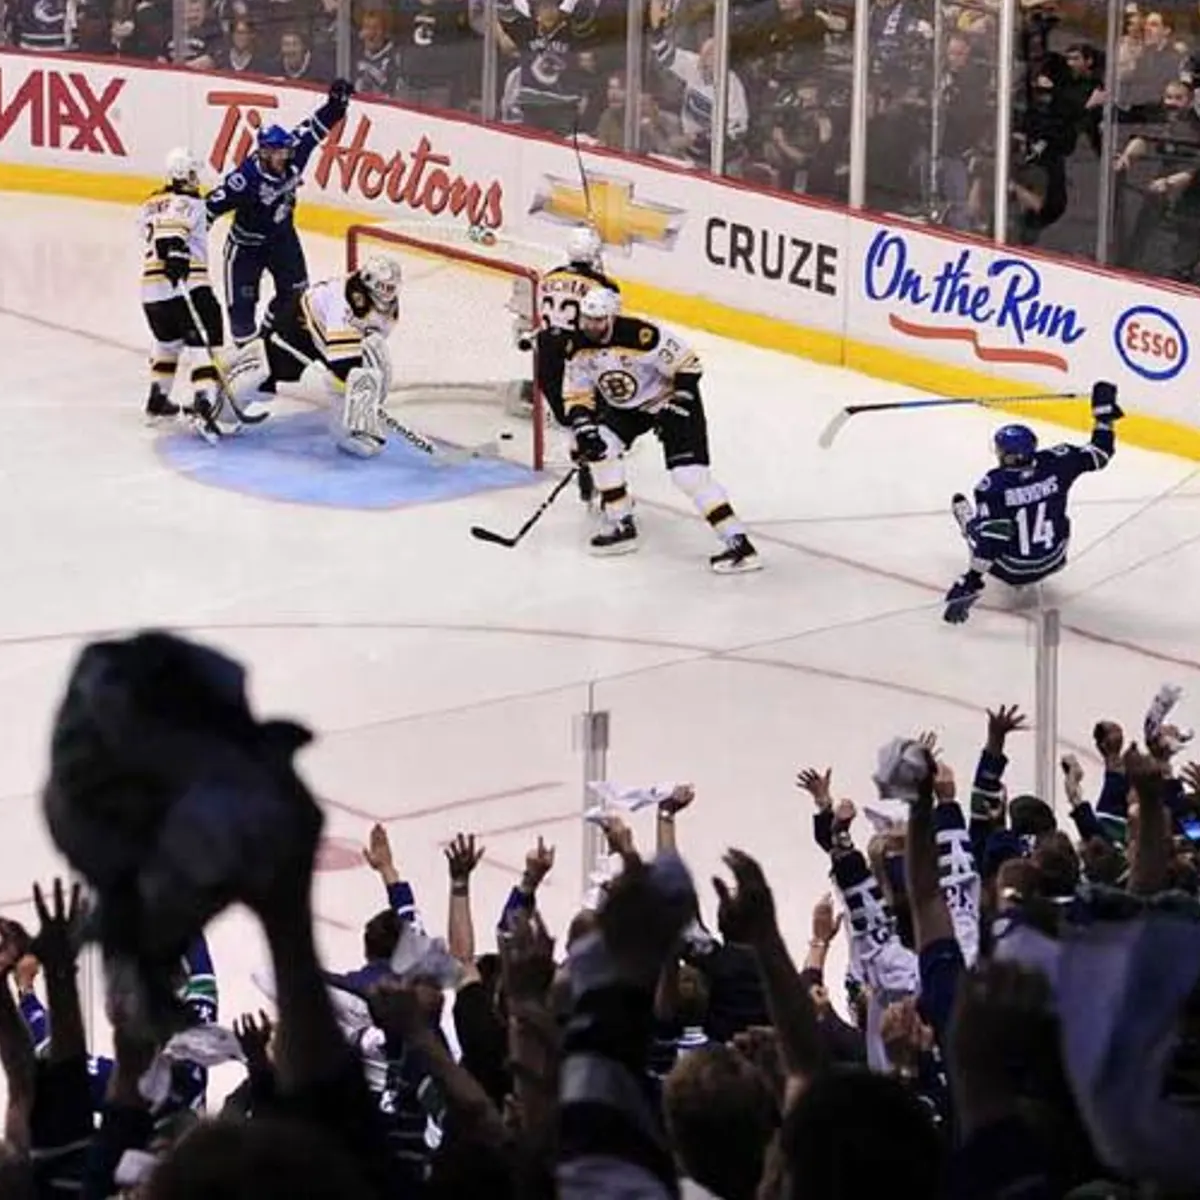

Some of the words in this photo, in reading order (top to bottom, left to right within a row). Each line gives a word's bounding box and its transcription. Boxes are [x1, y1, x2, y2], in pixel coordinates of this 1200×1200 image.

[207, 91, 281, 174] Ti
[314, 112, 503, 229] Hortons
[706, 217, 838, 295] CRUZE
[864, 230, 927, 301] On
[931, 250, 995, 323] the
[988, 259, 1086, 344] Run
[1016, 502, 1055, 556] 14
